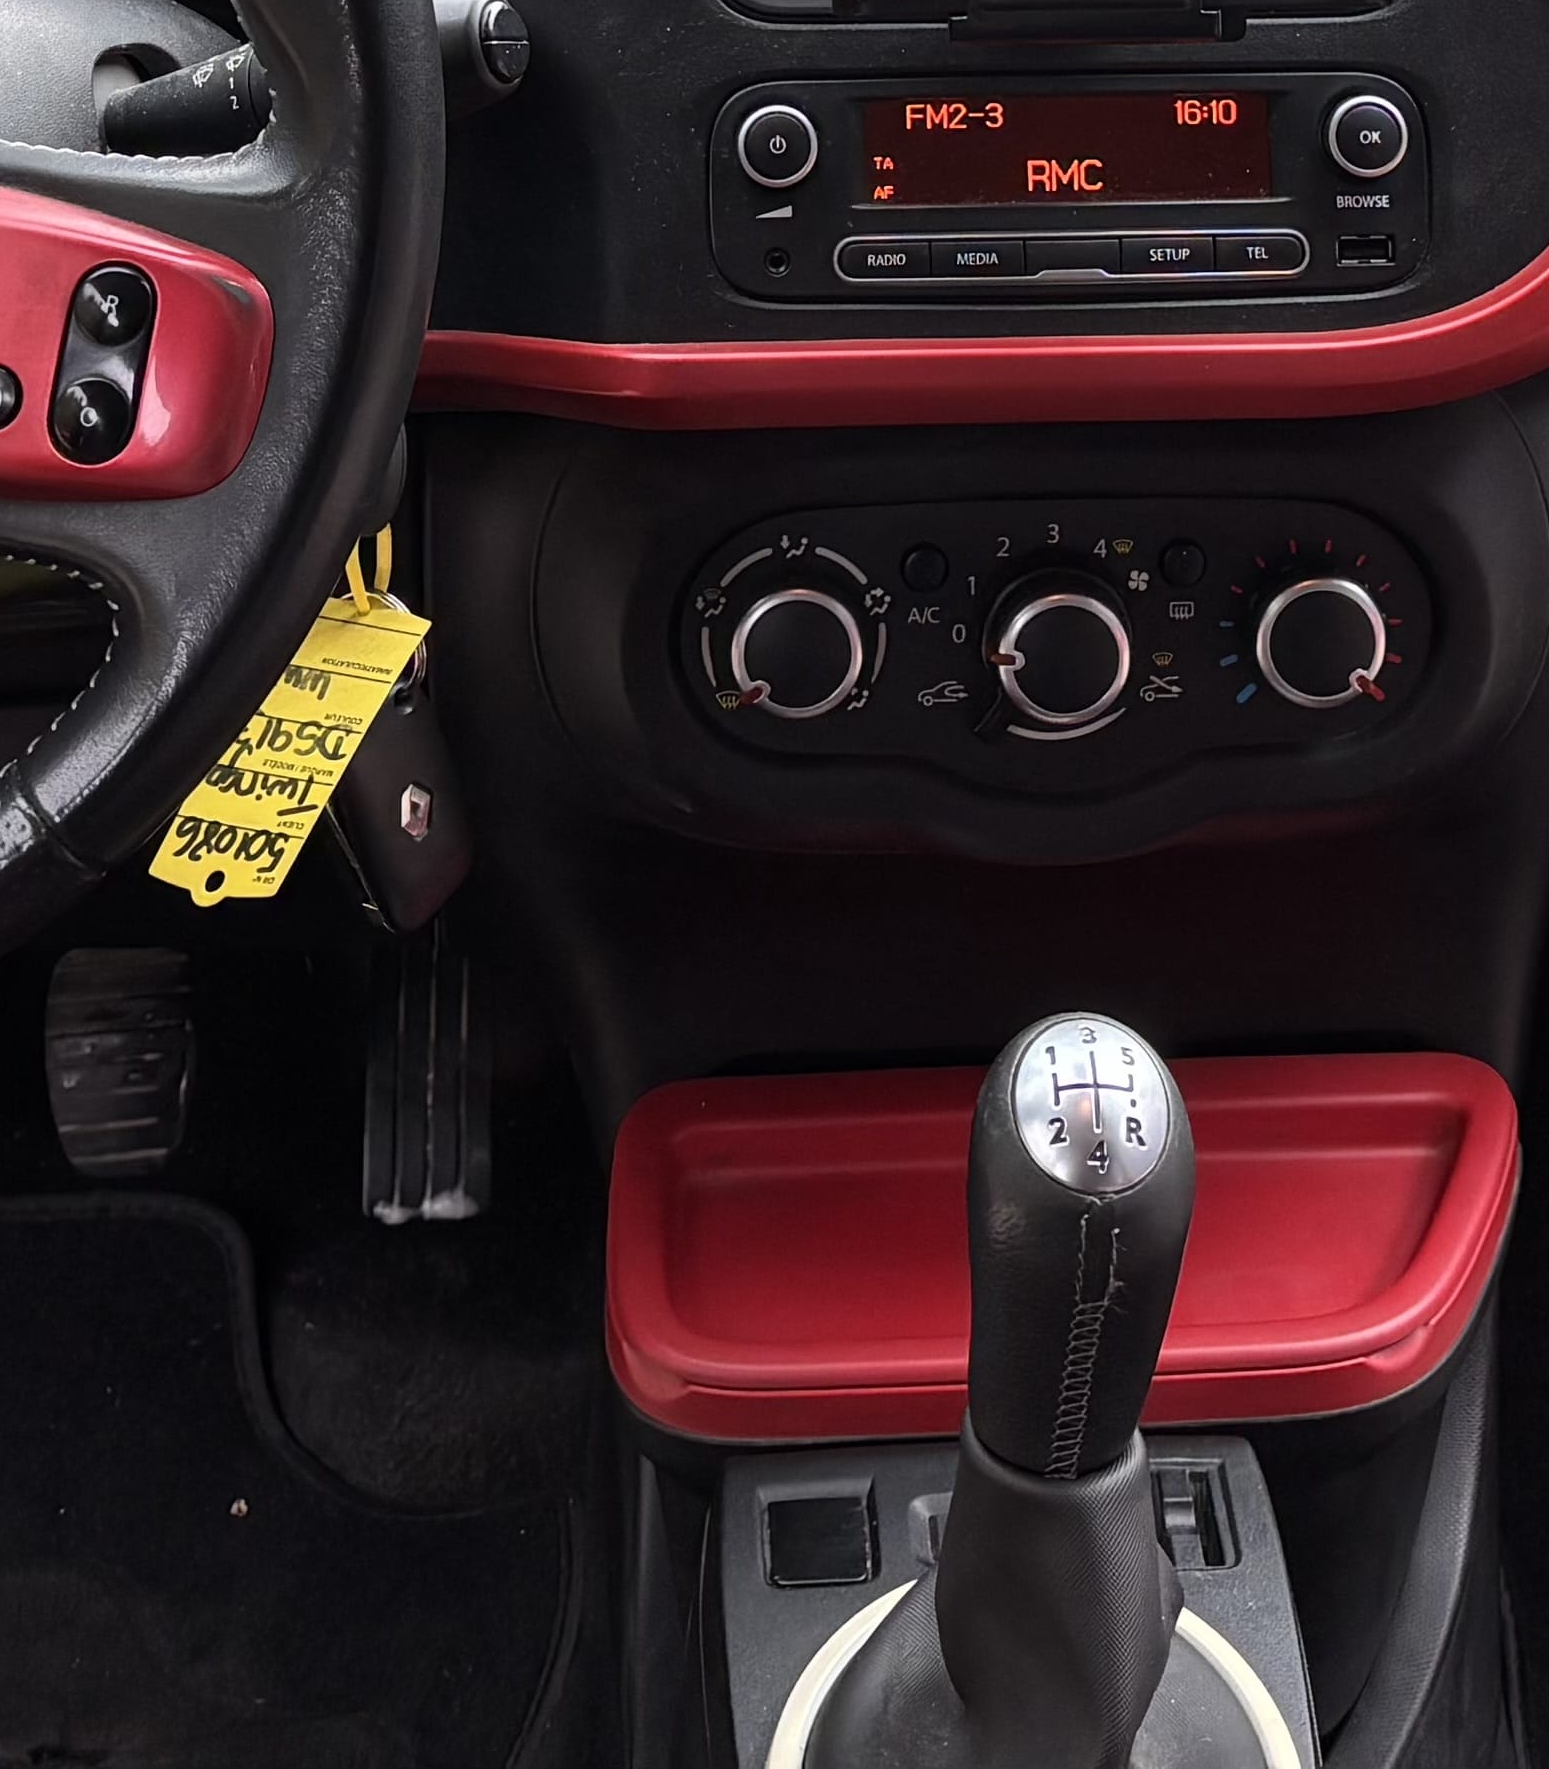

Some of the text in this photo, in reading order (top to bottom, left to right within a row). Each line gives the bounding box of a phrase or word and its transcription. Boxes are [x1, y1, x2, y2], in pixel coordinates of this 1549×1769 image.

[229, 95, 240, 110] 2
[905, 102, 1005, 130] FM2-3
[1173, 99, 1238, 126] 16:10
[1359, 129, 1382, 145] OK
[873, 155, 894, 171] TA
[1026, 159, 1104, 192] RMC
[873, 185, 894, 201] AF
[1336, 194, 1390, 209] BROWSE
[867, 253, 907, 267] RADIO
[956, 251, 1000, 267] MEDIA
[1149, 247, 1191, 262] SETUP
[1246, 245, 1269, 260] TEL
[952, 523, 1108, 644] 0 1 2 3 4
[907, 606, 941, 625] A/C
[276, 820, 306, 831] CLIENT
[1044, 1026, 1136, 1067] 1 3 5
[1047, 1116, 1148, 1174] 2 4 R
